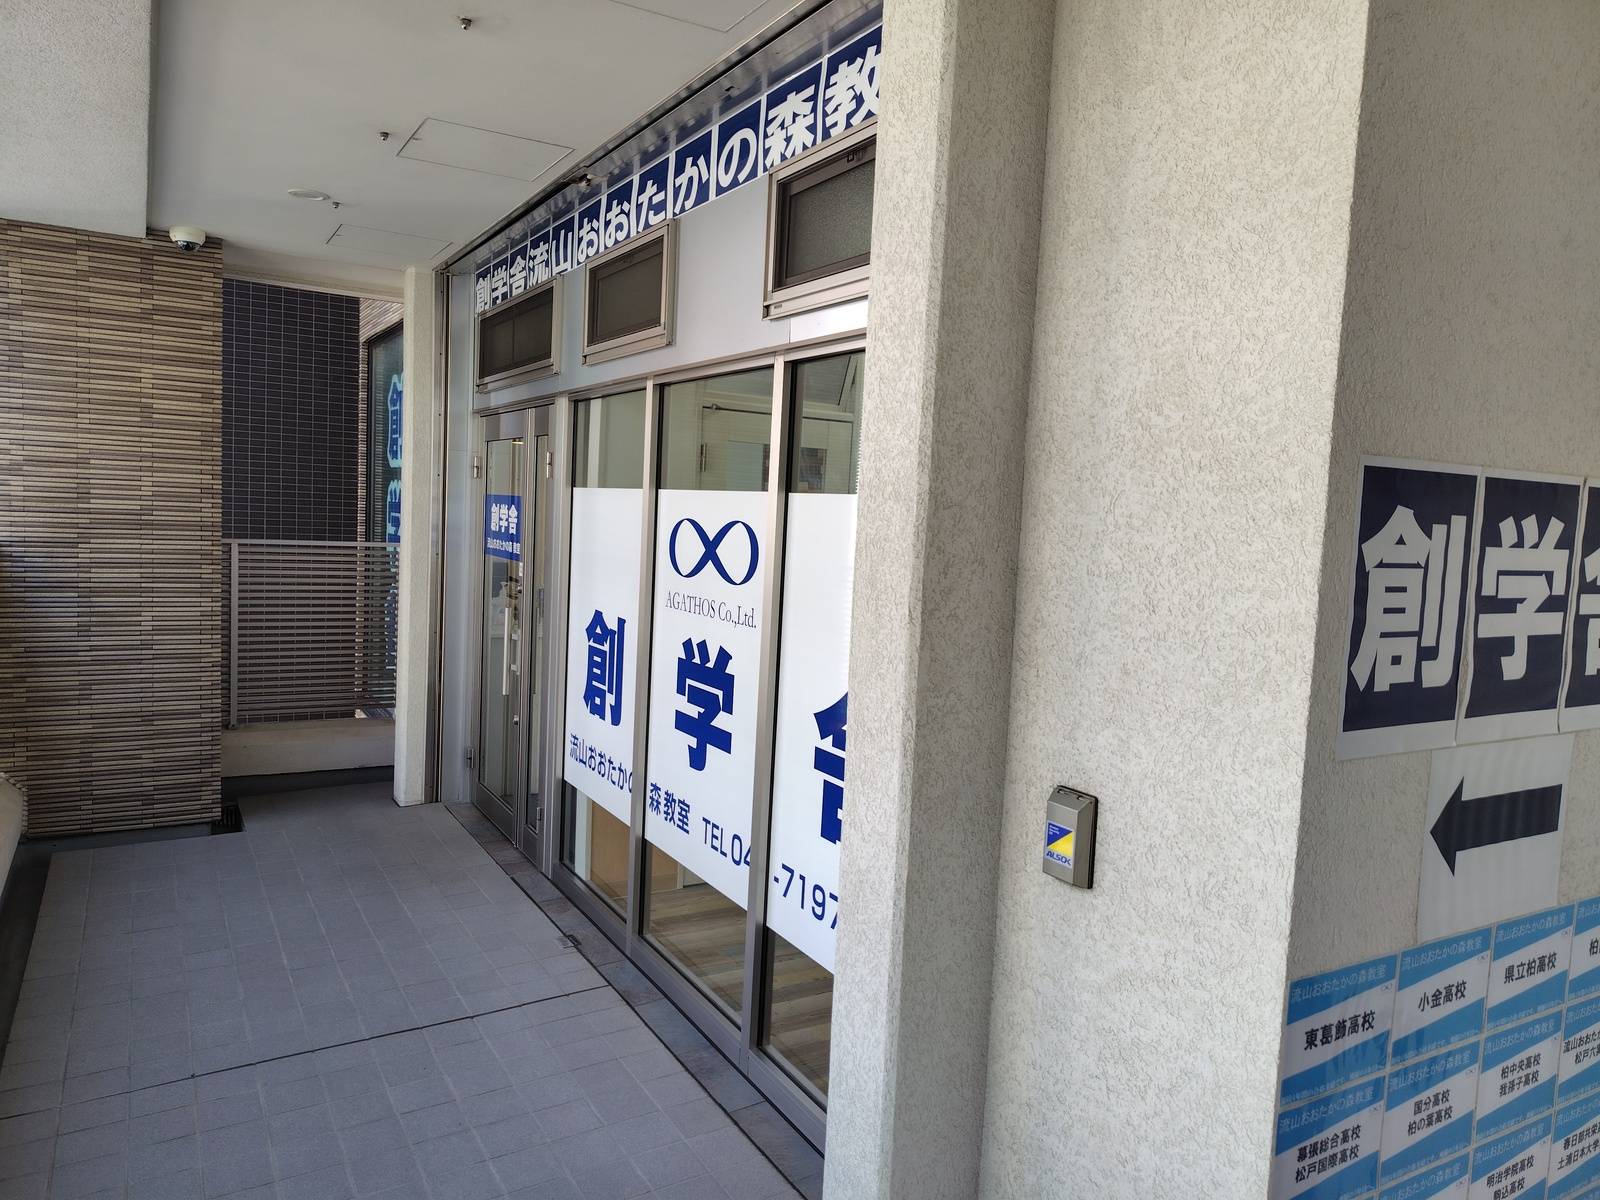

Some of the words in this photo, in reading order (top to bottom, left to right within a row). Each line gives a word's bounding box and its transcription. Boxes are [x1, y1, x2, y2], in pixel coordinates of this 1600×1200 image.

[491, 503, 518, 534] 創学舎
[665, 590, 716, 619] AGATHOS
[1350, 504, 1600, 692] 創学
[649, 782, 691, 835] 森教室
[1046, 850, 1072, 866] ALSOK
[1503, 951, 1557, 984] 県立柏高校
[1418, 980, 1467, 1012] 小金高校
[1304, 1009, 1376, 1051] 東葛飾高校
[1501, 1052, 1541, 1079] 柏中央高校
[1499, 1070, 1539, 1097] 我孫子高校
[1413, 1088, 1450, 1116] 国分高校
[1407, 1105, 1453, 1137] 柏の葉高校
[1297, 1124, 1361, 1163] 幕張総合高校
[1295, 1143, 1360, 1184] 松戸国際高校
[1486, 1154, 1535, 1189] 明治学院高校
